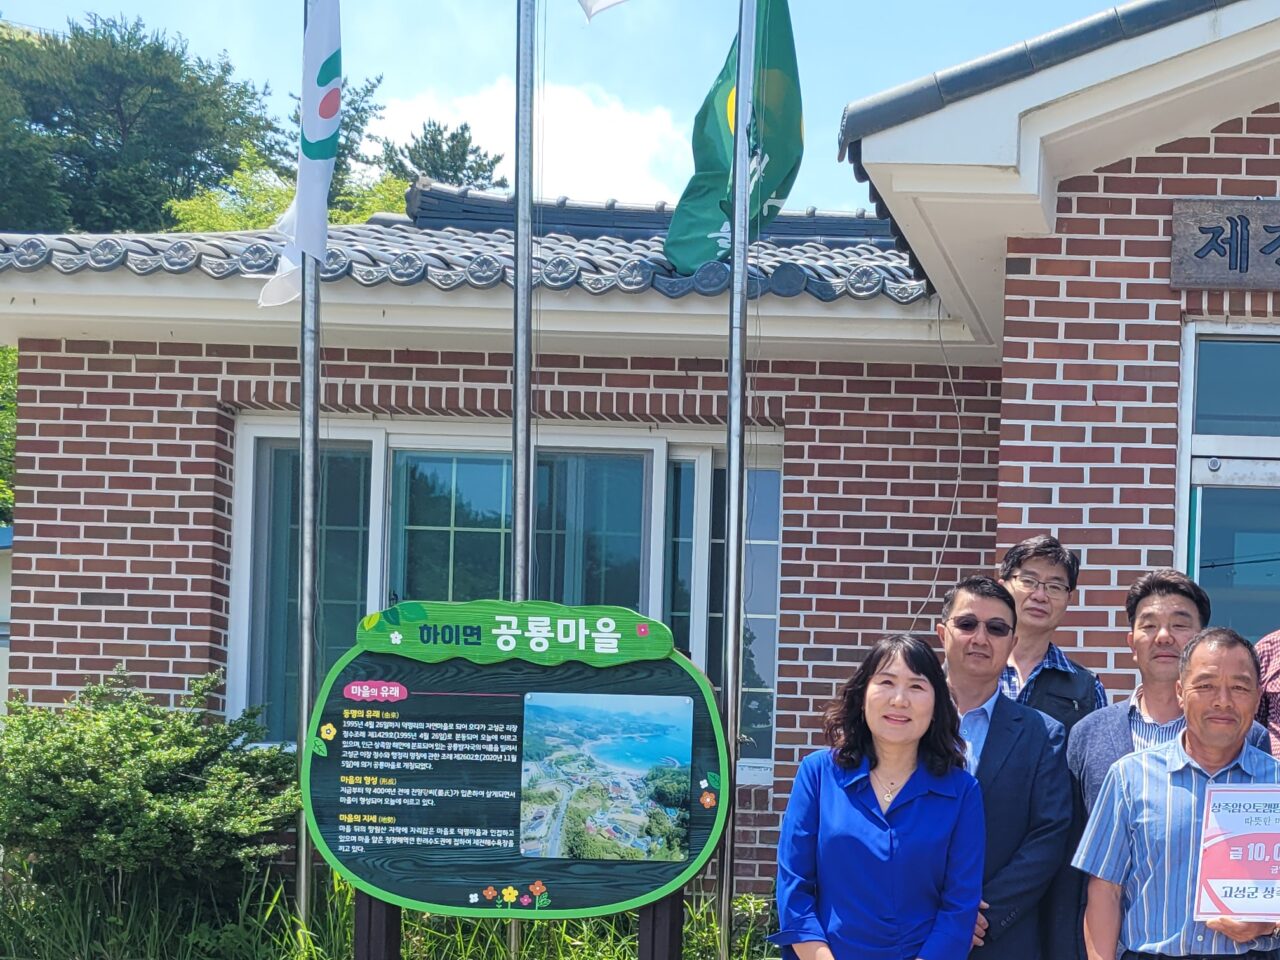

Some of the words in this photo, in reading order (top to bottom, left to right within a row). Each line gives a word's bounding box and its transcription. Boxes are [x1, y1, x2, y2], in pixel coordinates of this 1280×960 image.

[419, 624, 482, 646] 하이면
[491, 615, 622, 654] 공룡마을
[351, 685, 378, 698] 마을의
[380, 686, 400, 698] 유래
[365, 710, 380, 719] 유래
[364, 721, 375, 729] 4월
[456, 723, 468, 731] 되어
[469, 723, 486, 731] 오다가
[487, 724, 505, 732] 고성군
[419, 732, 429, 740] 4월
[480, 734, 499, 742] 오늘에
[500, 734, 518, 742] 이르고
[435, 743, 446, 751] 있는
[342, 750, 359, 759] 고성군
[340, 775, 362, 785] 마을의
[364, 776, 378, 785] 형성
[340, 786, 364, 794] 지금부터
[373, 787, 396, 796] 400여년
[339, 796, 358, 804] 마을이
[384, 797, 402, 806] 오늘에
[403, 798, 420, 806] 이르고
[339, 814, 361, 823] 마을의
[362, 814, 377, 823] 지세
[1244, 816, 1271, 827] 따뜻한
[338, 825, 352, 833] 마을
[436, 827, 455, 836] 마을로
[357, 835, 370, 844] 마을
[351, 845, 366, 853] 있다.
[1229, 846, 1243, 861] 금
[1222, 886, 1258, 899] 고성군
